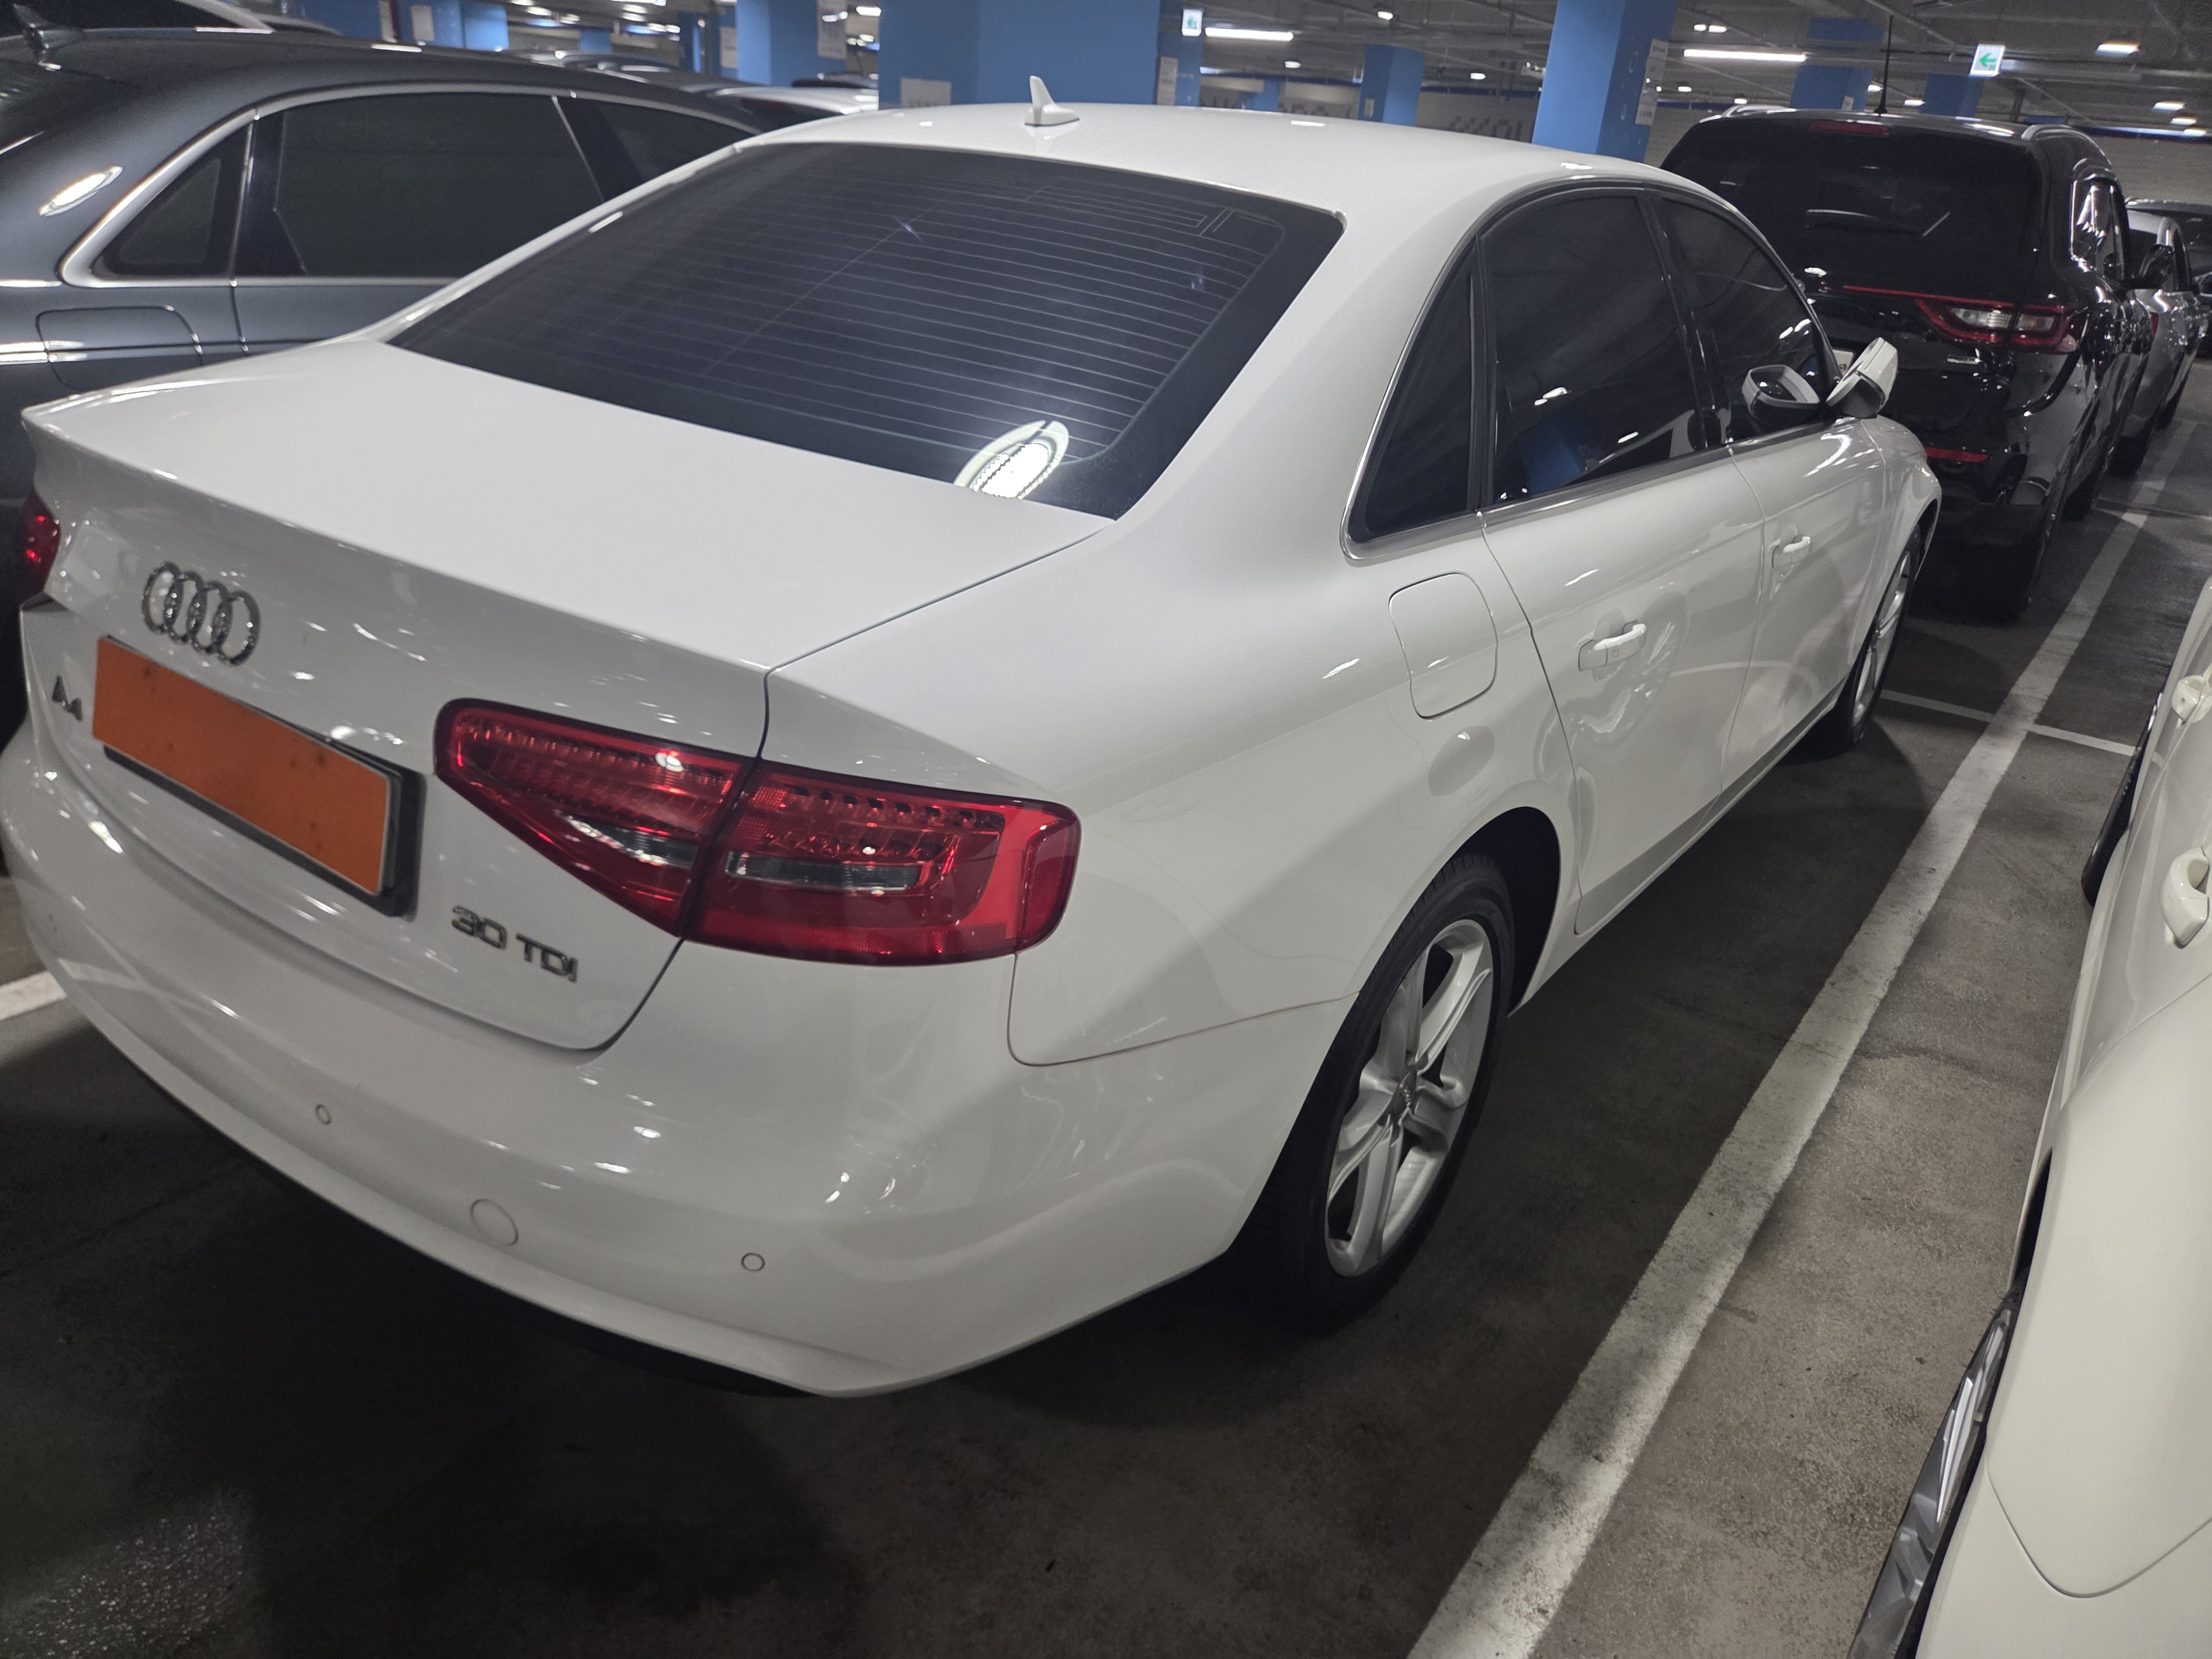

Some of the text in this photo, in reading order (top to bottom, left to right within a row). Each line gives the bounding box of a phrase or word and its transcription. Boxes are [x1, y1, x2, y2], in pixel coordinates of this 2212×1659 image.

[52, 675, 83, 722] A4
[451, 905, 578, 982] 30 TDI
